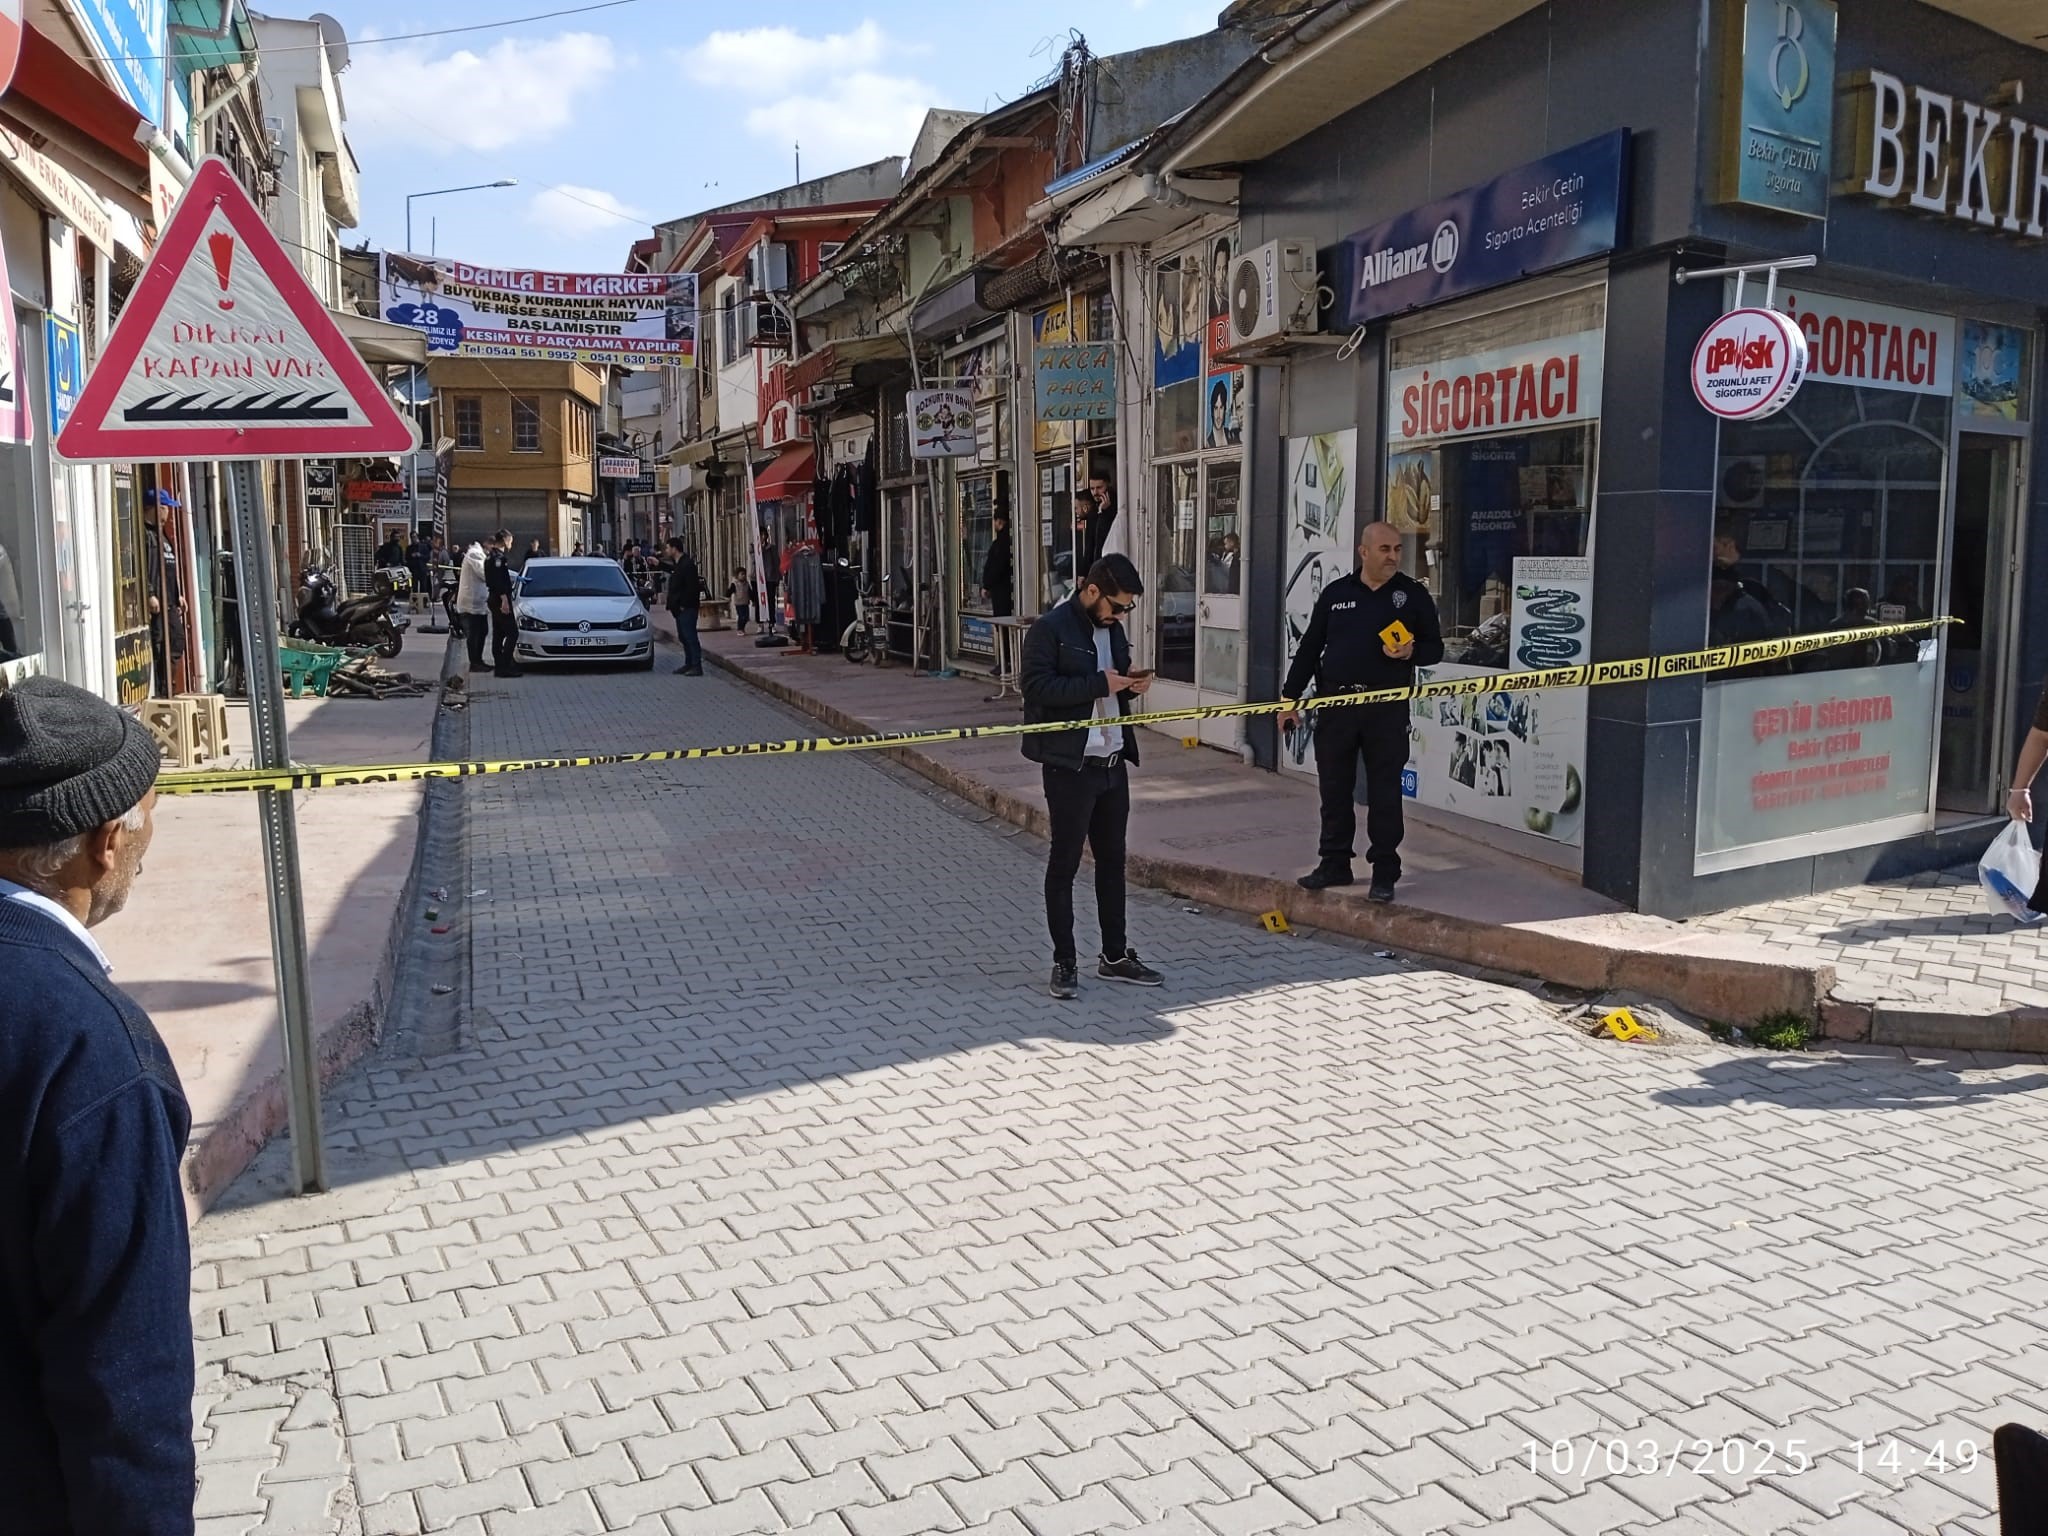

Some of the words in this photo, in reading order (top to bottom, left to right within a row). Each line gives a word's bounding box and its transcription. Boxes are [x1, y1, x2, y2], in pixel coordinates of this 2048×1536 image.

[1748, 138, 1779, 162] Bekir
[1781, 146, 1820, 171] ÇETİN
[1521, 185, 1549, 210] Bekir
[1552, 172, 1584, 199] Çetin
[1765, 170, 1801, 193] Sigorta
[1485, 226, 1523, 250] Sigorta
[1526, 200, 1583, 234] Acenteliği
[1360, 242, 1430, 291] Allianz
[459, 265, 534, 290] DAMLA
[543, 274, 568, 292] ET
[576, 276, 662, 295] MARKET
[1265, 250, 1273, 316] BEKO
[443, 284, 521, 305] BÜYÜKBAŞ
[525, 295, 604, 308] KURBANLIK
[608, 299, 664, 310] HAYVAN
[412, 309, 438, 324] 28
[472, 301, 491, 312] VE
[542, 308, 637, 322] SATIŞLARIMIZ
[508, 319, 622, 336] BAŞLAMIŞTIR
[515, 334, 533, 344] VE
[537, 336, 623, 350] PARÇALAMA
[628, 341, 684, 352] YAPILIR.
[520, 347, 542, 358] 561
[547, 351, 577, 360] 9952
[590, 353, 619, 362] 0541
[623, 355, 645, 364] 630
[649, 356, 663, 365] 55
[667, 356, 681, 365] 33
[1040, 351, 1108, 372] AKÇA
[1706, 334, 1777, 375] dask
[144, 356, 253, 378] KAPAN
[266, 357, 326, 377] VAR
[1047, 380, 1103, 397] PAÇA
[1706, 377, 1748, 388] ZORUNLU
[1749, 375, 1773, 386] AFET
[1402, 354, 1579, 438] SİGORTACI
[1715, 388, 1761, 398] SİGORTASI
[307, 487, 334, 496] CASTRO
[433, 473, 448, 535] CASTRO
[1270, 915, 1279, 928] 2
[1615, 1017, 1629, 1031] 3
